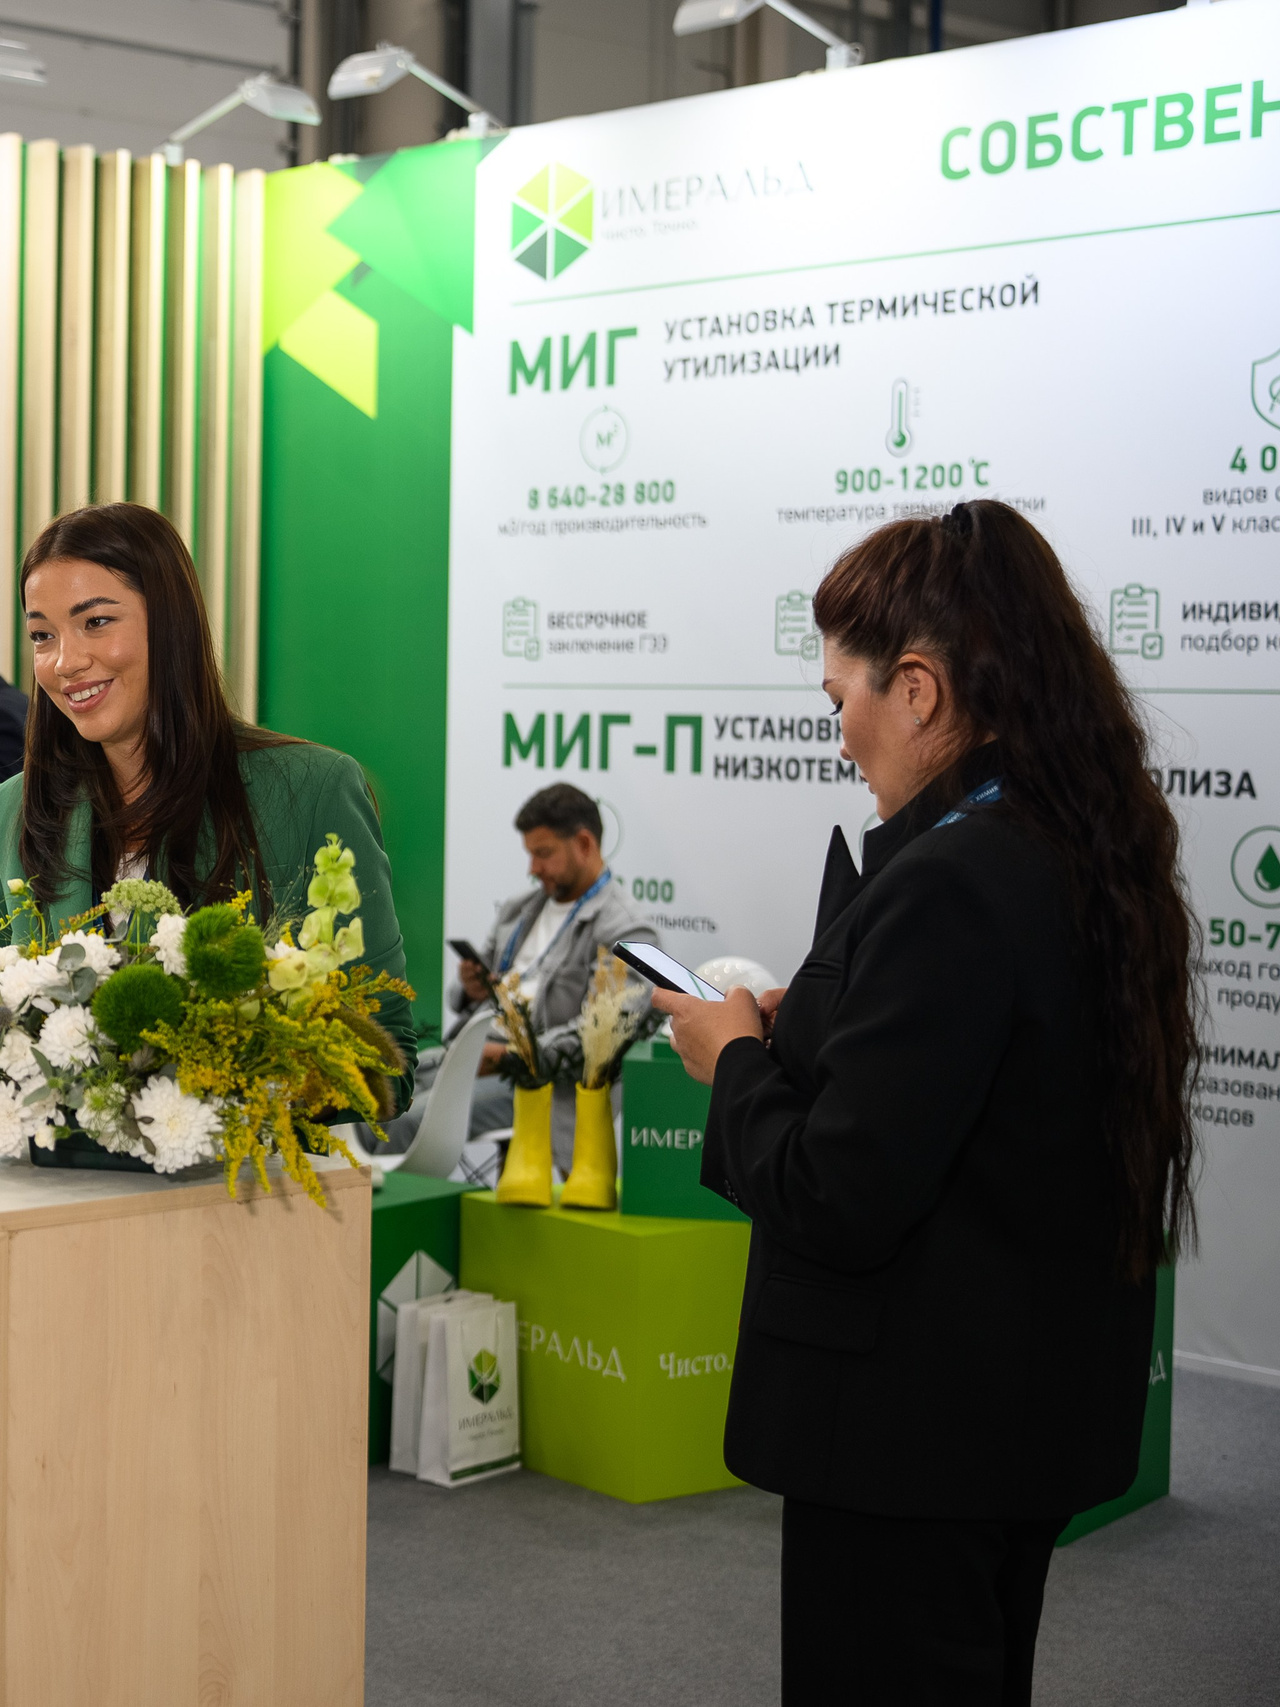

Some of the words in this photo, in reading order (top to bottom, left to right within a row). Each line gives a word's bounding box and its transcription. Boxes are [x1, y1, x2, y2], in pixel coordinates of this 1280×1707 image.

[940, 80, 1280, 181] СОБСТВЕН
[601, 160, 815, 220] ИМЕРАЛЬД
[508, 326, 638, 397] МИГ
[663, 303, 816, 343] УСТАНОВКА
[826, 273, 1040, 325] ТЕРМИЧЕСКОЙ
[663, 342, 842, 382] УТИЛИЗАЦИИ
[634, 479, 676, 505] 800
[1203, 486, 1268, 507] видов
[777, 503, 886, 524] температура
[547, 610, 648, 630] БЕССРОЧНОЕ
[1181, 600, 1280, 624] ИНДИВИ
[547, 638, 634, 654] заключение
[1180, 629, 1260, 657] подбор
[502, 711, 704, 775] МИГ-П
[712, 755, 863, 784] НИЗКОТЕМ
[630, 1125, 704, 1150] ИМЕР
